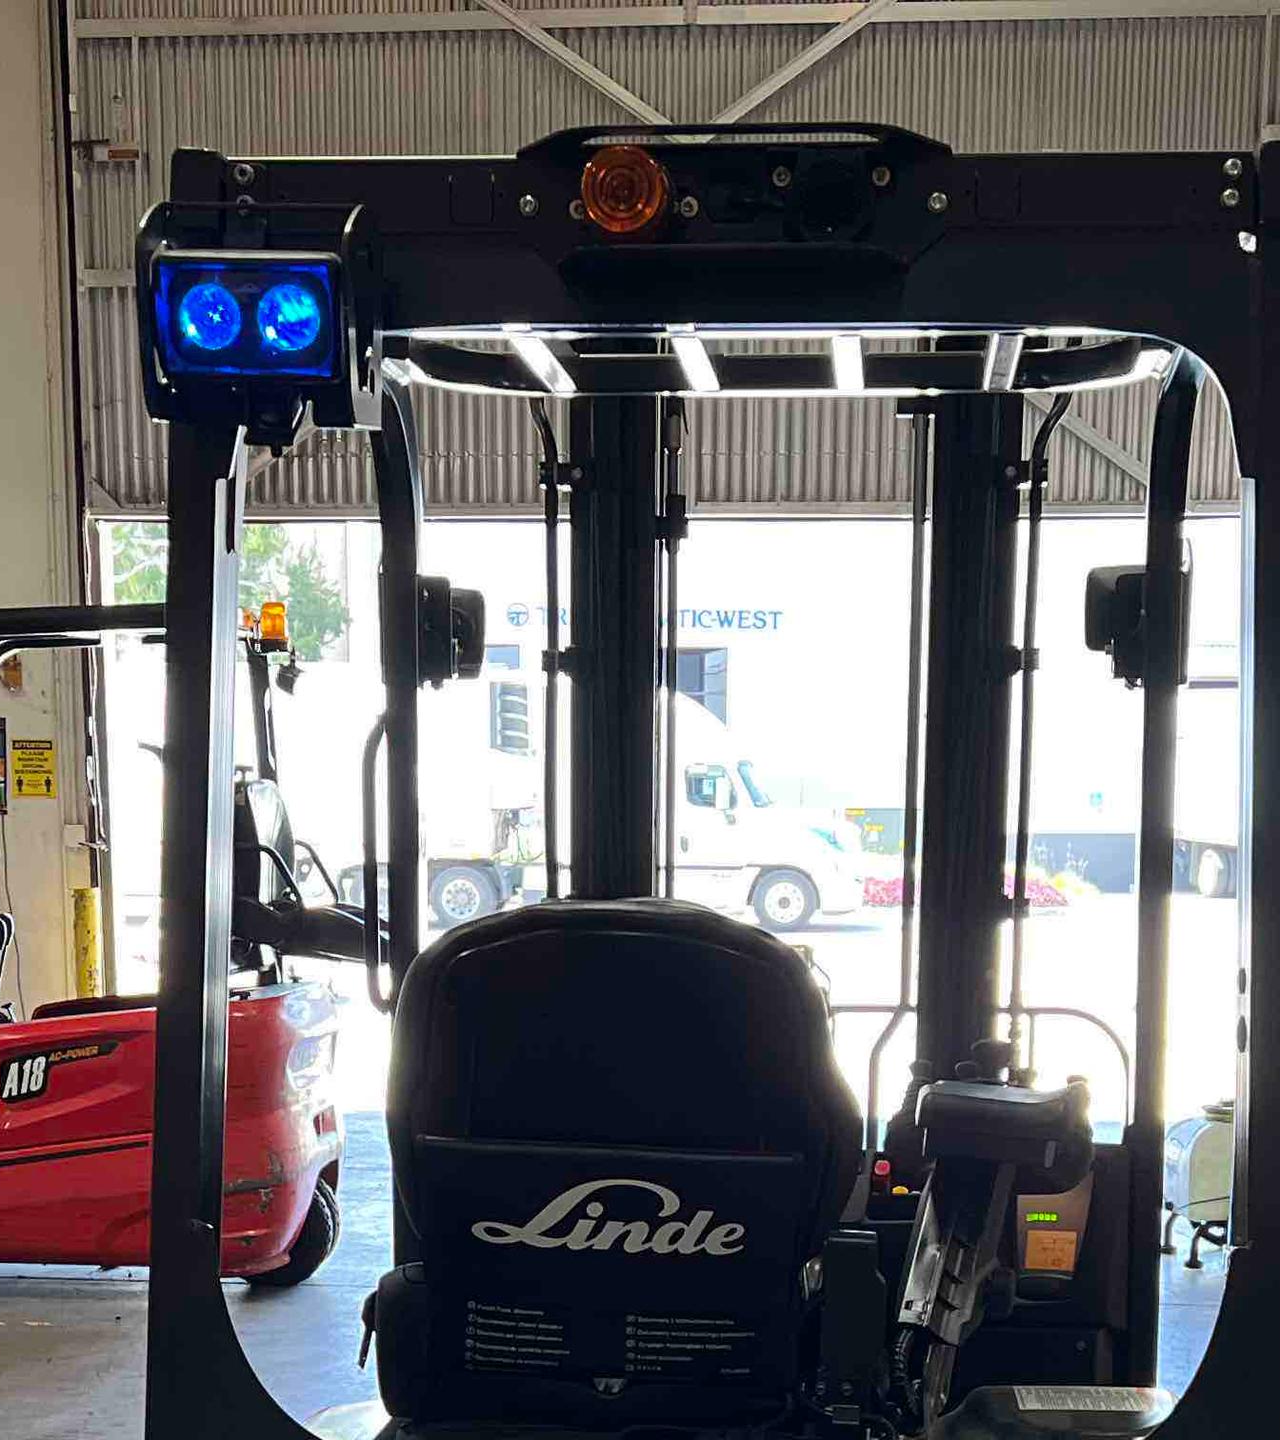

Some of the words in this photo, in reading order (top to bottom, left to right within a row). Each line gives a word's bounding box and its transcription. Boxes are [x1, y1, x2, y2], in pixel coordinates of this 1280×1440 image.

[49, 1046, 99, 1062] AC-POWER
[2, 1056, 46, 1098] A18
[471, 1178, 745, 1256] Linde
